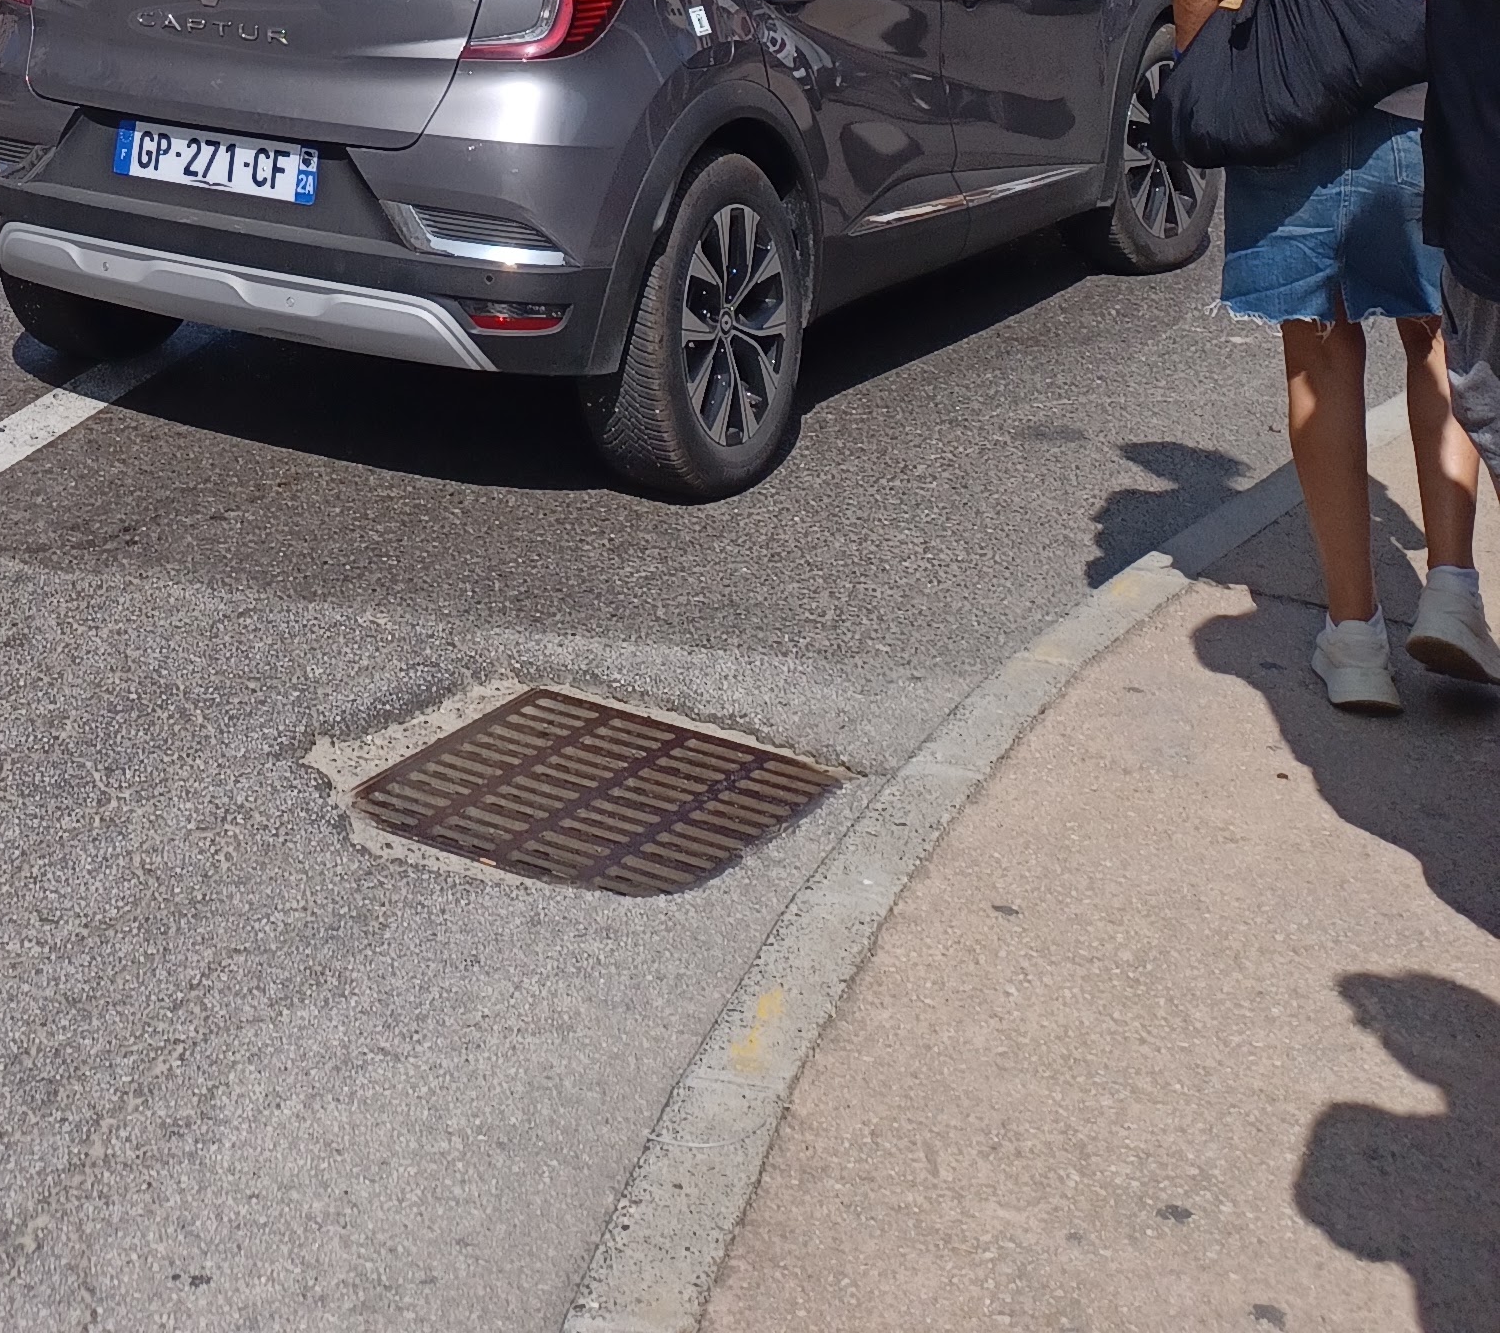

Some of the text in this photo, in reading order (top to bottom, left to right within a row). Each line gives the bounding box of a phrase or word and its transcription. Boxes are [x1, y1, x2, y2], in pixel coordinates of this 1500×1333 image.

[136, 9, 290, 45] CAPTUR
[120, 131, 314, 195] F GP-271-CF 2A
